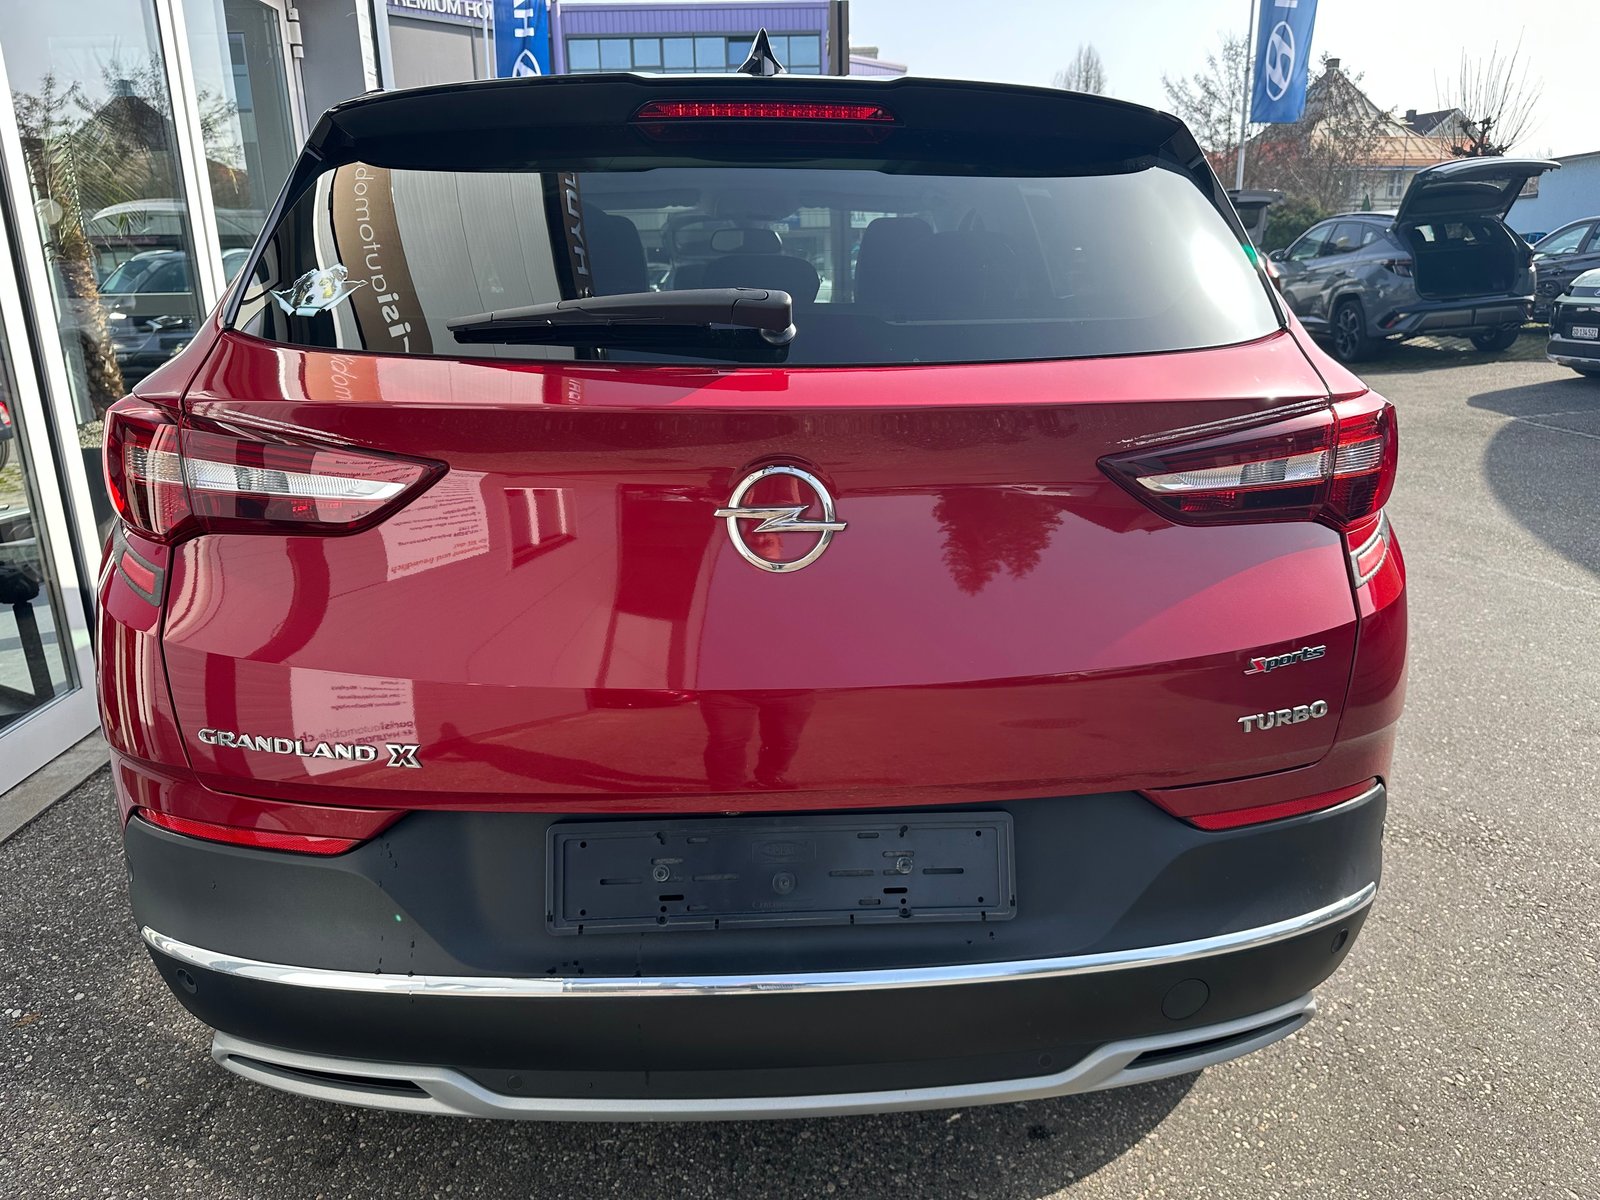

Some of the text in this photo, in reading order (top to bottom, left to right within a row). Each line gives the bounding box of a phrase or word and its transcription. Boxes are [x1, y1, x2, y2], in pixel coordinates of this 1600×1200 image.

[464, 1, 493, 20] HO
[1243, 645, 1326, 675] Sports
[1238, 699, 1328, 733] TURBO
[198, 728, 423, 768] GRANDLAND X
